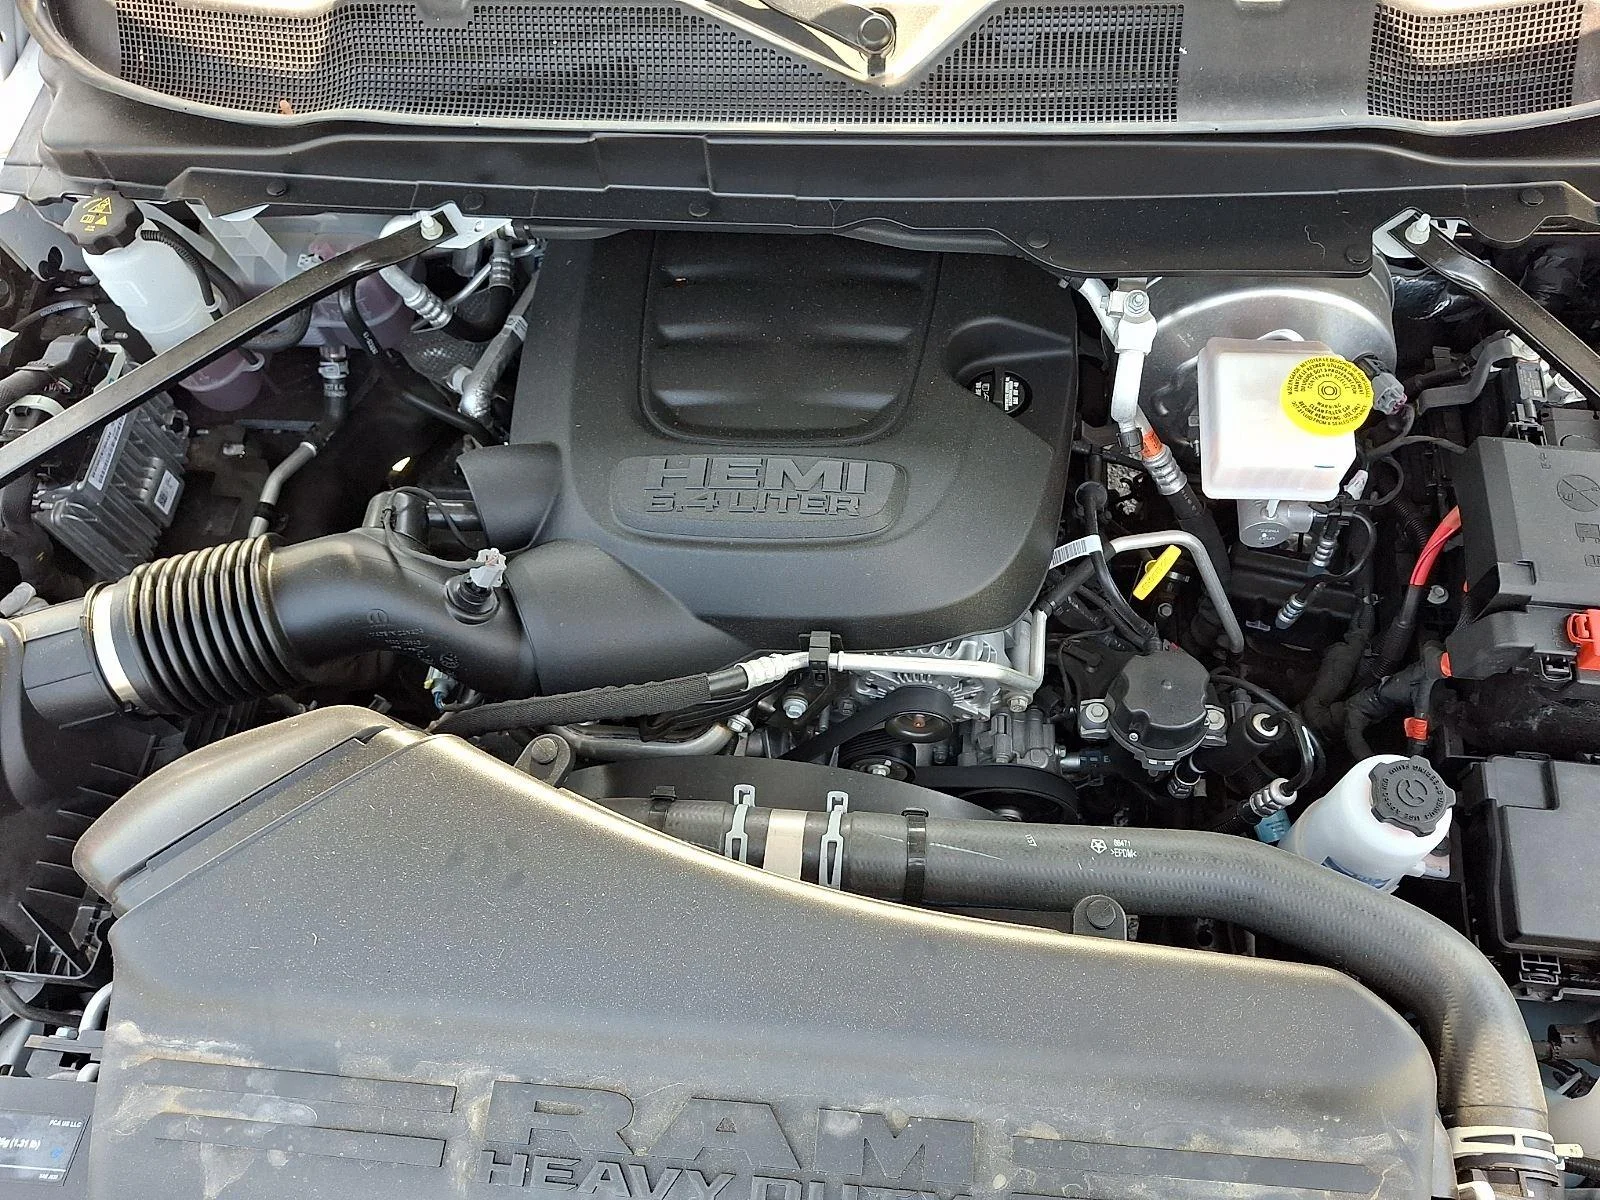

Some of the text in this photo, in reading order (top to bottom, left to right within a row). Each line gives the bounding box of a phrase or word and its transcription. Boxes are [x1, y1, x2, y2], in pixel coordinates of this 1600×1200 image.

[1298, 400, 1314, 415] BEFORE
[1308, 403, 1325, 414] CLEAN
[1315, 401, 1342, 410] WARNING
[645, 456, 869, 494] HEMI
[728, 491, 861, 517] LITER
[1412, 764, 1444, 795] STEERING
[1404, 813, 1421, 821] USE
[1424, 797, 1444, 820] POWER
[484, 1080, 976, 1186] RAM
[477, 1149, 973, 1200] HEAVY DU
